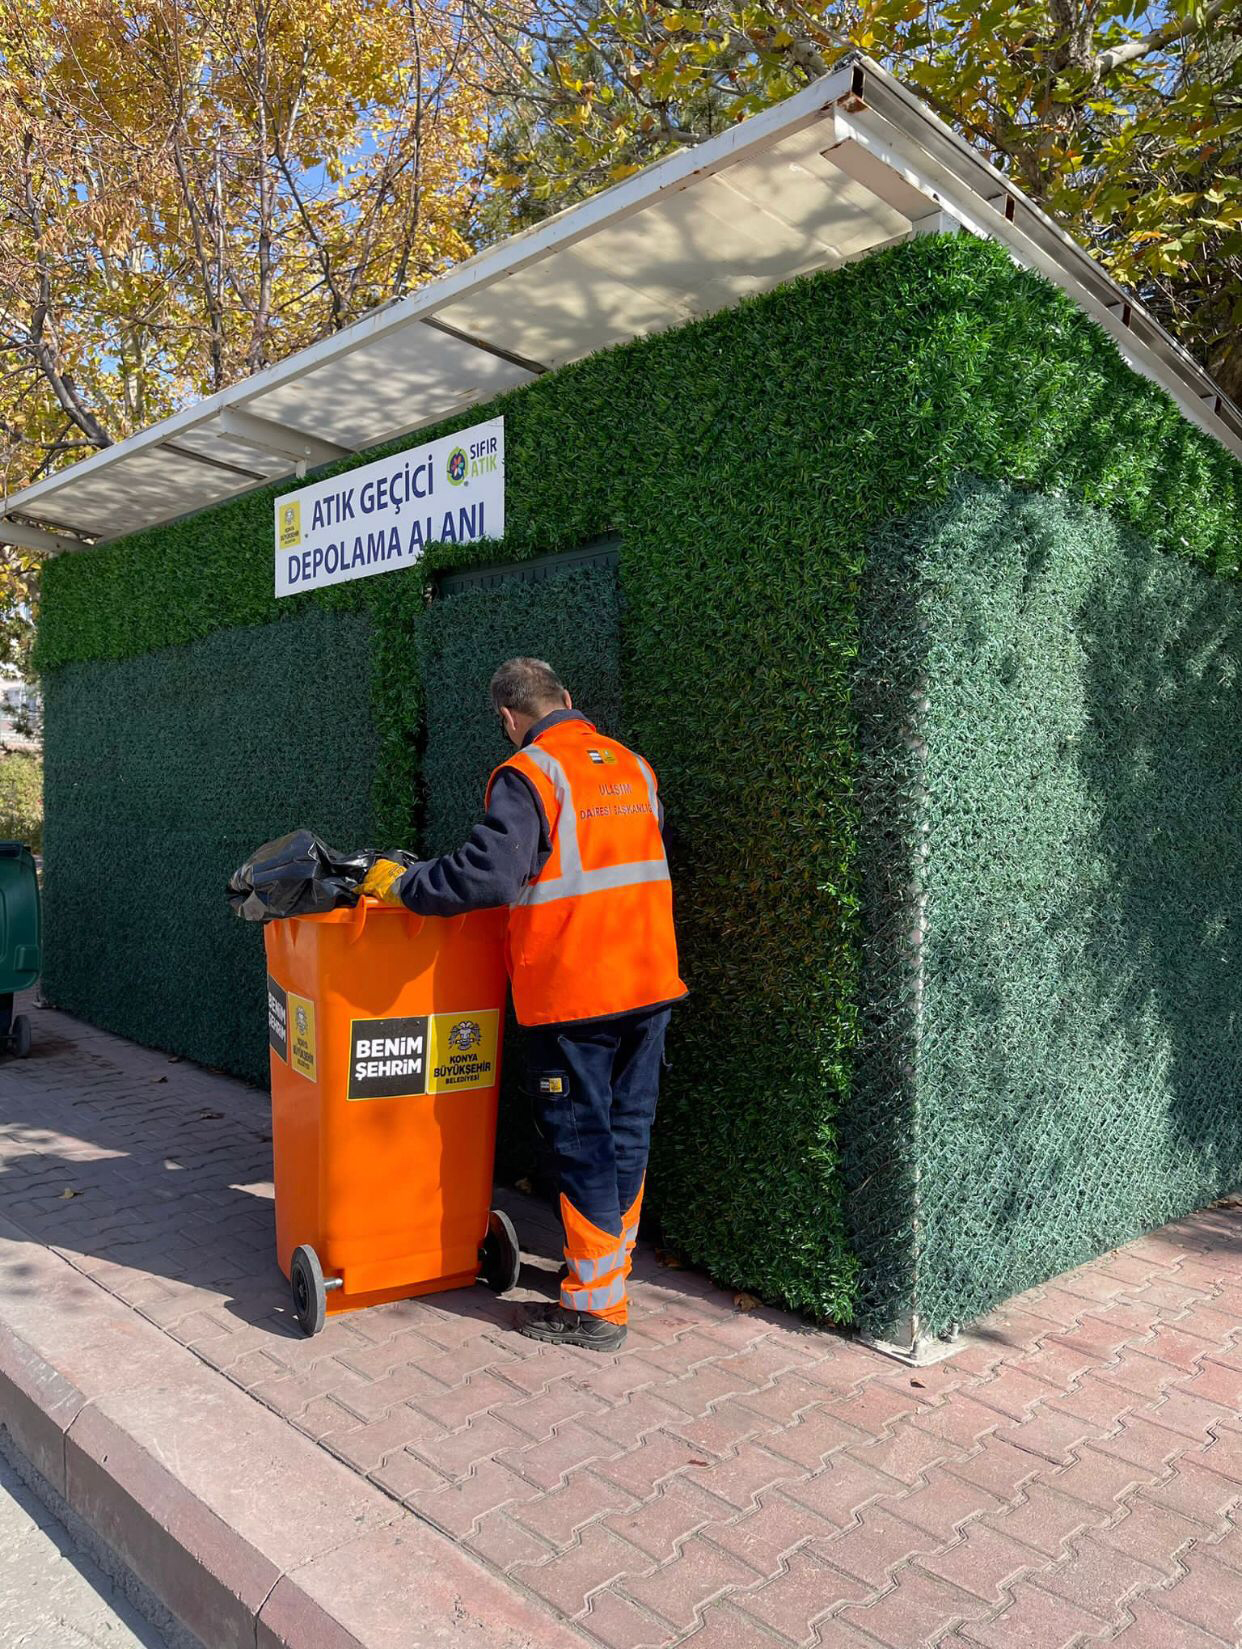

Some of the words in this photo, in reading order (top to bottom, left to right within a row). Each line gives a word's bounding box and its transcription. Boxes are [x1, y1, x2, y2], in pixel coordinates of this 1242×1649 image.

[470, 437, 497, 460] SIFIR
[471, 454, 497, 477] ATIK
[312, 488, 355, 531] ATIK
[360, 454, 433, 514] GEÇİCİ
[288, 527, 402, 584] DEPOLAMA
[434, 1060, 491, 1078] BÜYÜKŞEHİR
[450, 1054, 478, 1064] KONYA
